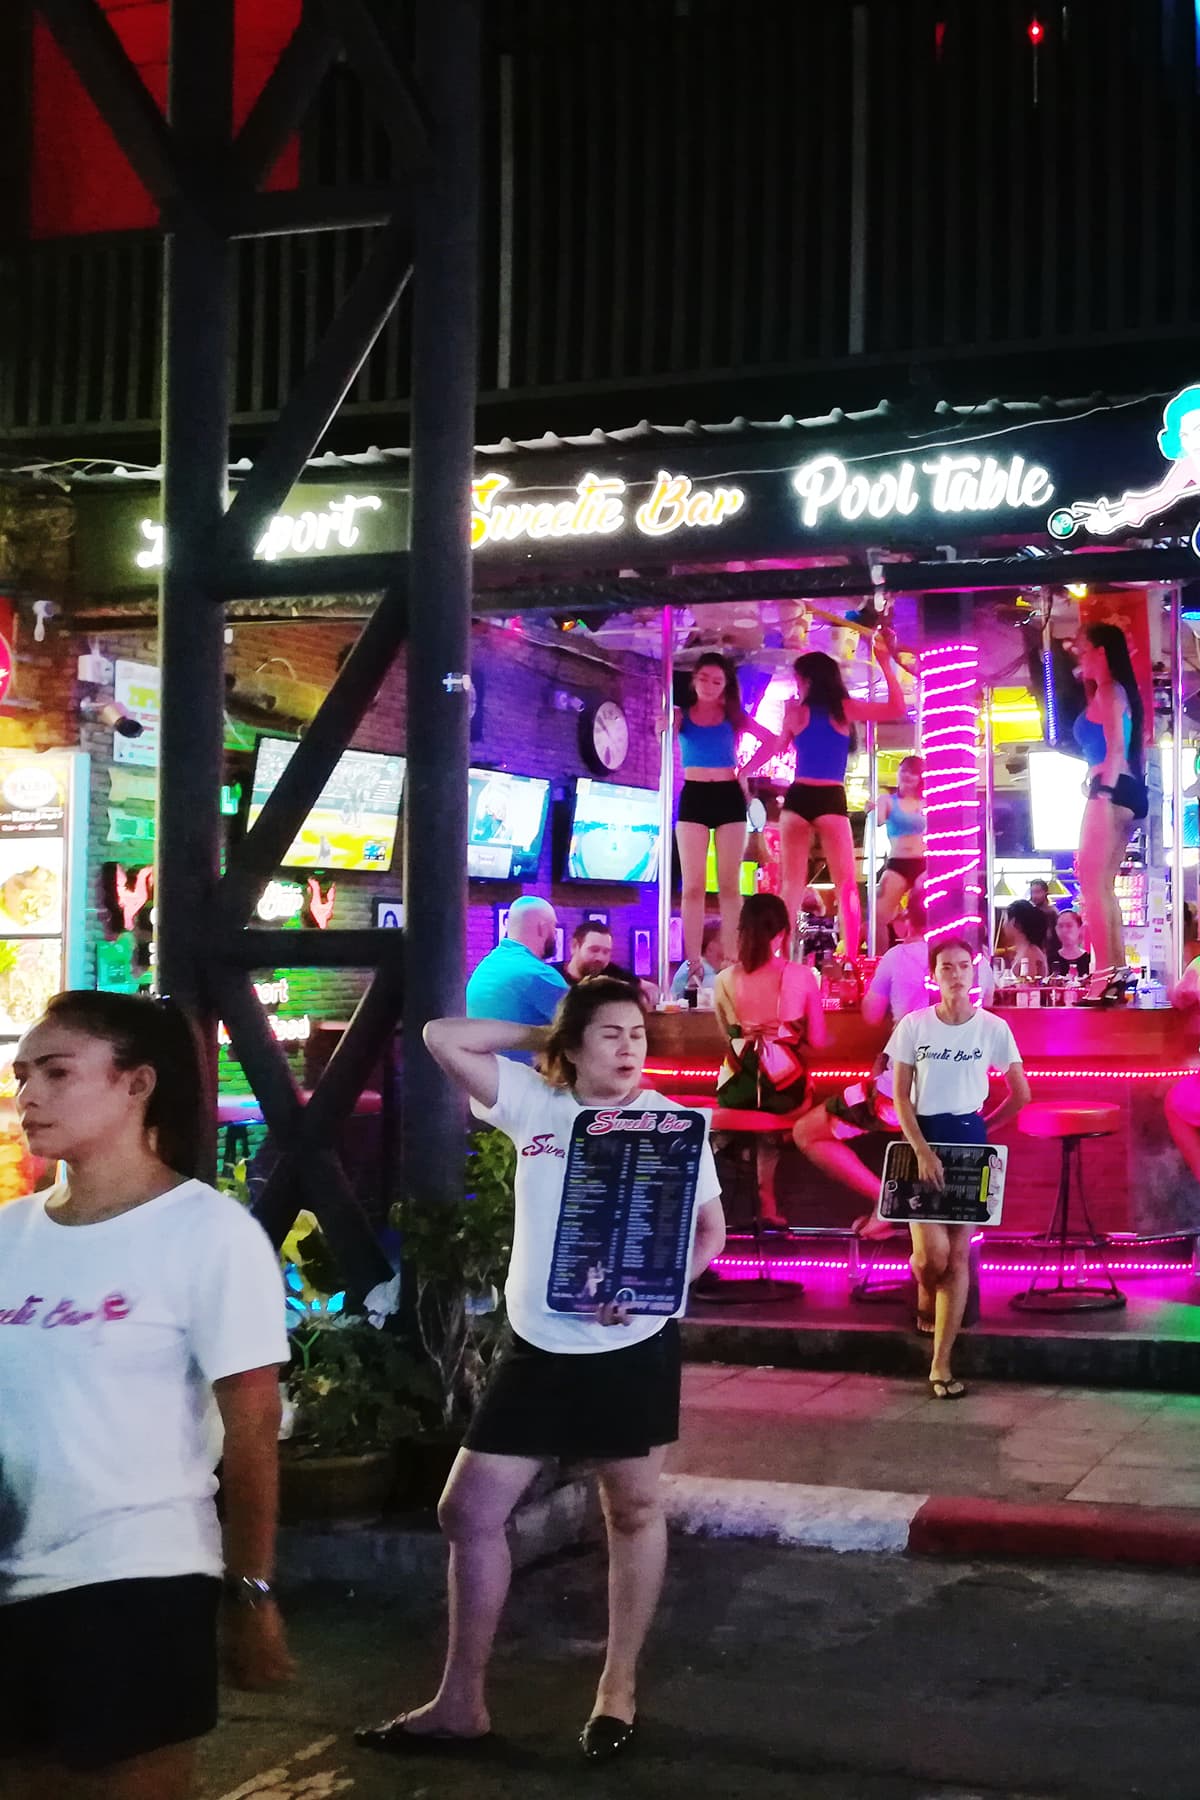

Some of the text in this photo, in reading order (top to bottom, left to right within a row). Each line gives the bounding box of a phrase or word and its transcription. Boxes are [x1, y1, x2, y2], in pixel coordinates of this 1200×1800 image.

[471, 470, 744, 549] Sweetie Bar
[795, 456, 919, 527] Pool
[253, 494, 382, 560] port
[657, 1112, 693, 1134] Bar
